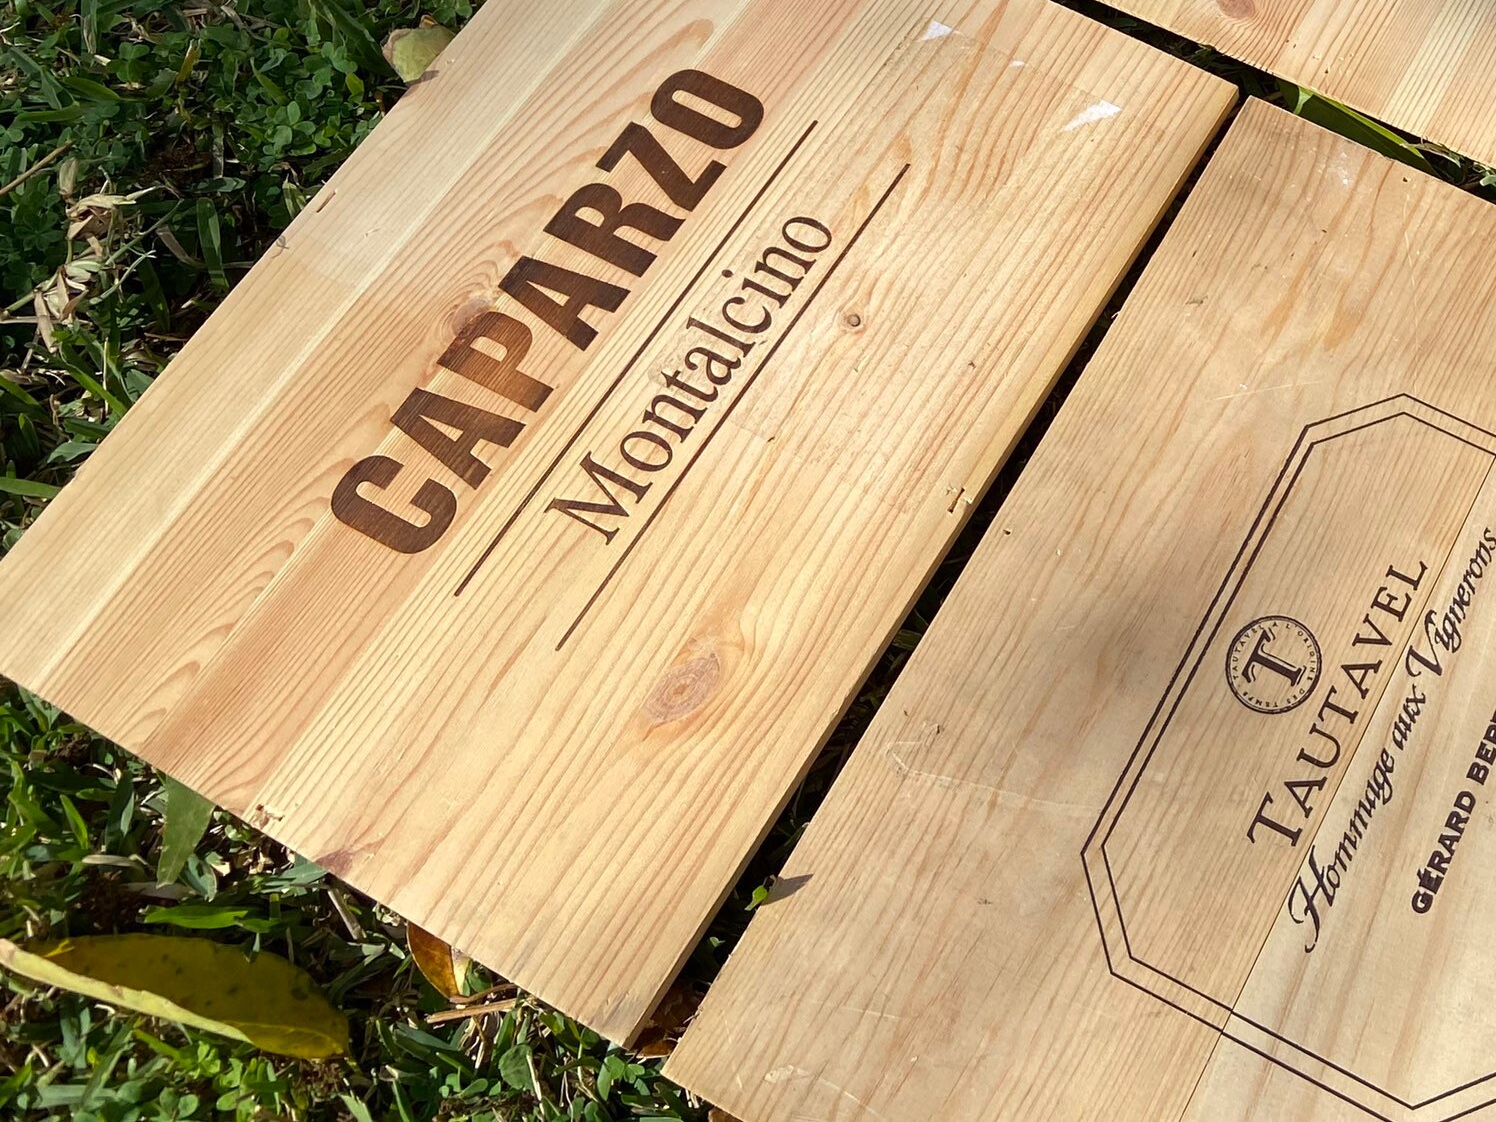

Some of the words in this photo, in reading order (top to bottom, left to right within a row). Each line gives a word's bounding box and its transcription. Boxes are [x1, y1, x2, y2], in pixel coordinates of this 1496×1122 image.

[330, 68, 765, 555] CAPARZO
[543, 215, 834, 546] Montalcino
[1246, 560, 1429, 848] TAUTAVEL
[1286, 748, 1396, 955] Hommage
[1391, 684, 1428, 750] aux
[1411, 790, 1477, 914] GÉRARD
